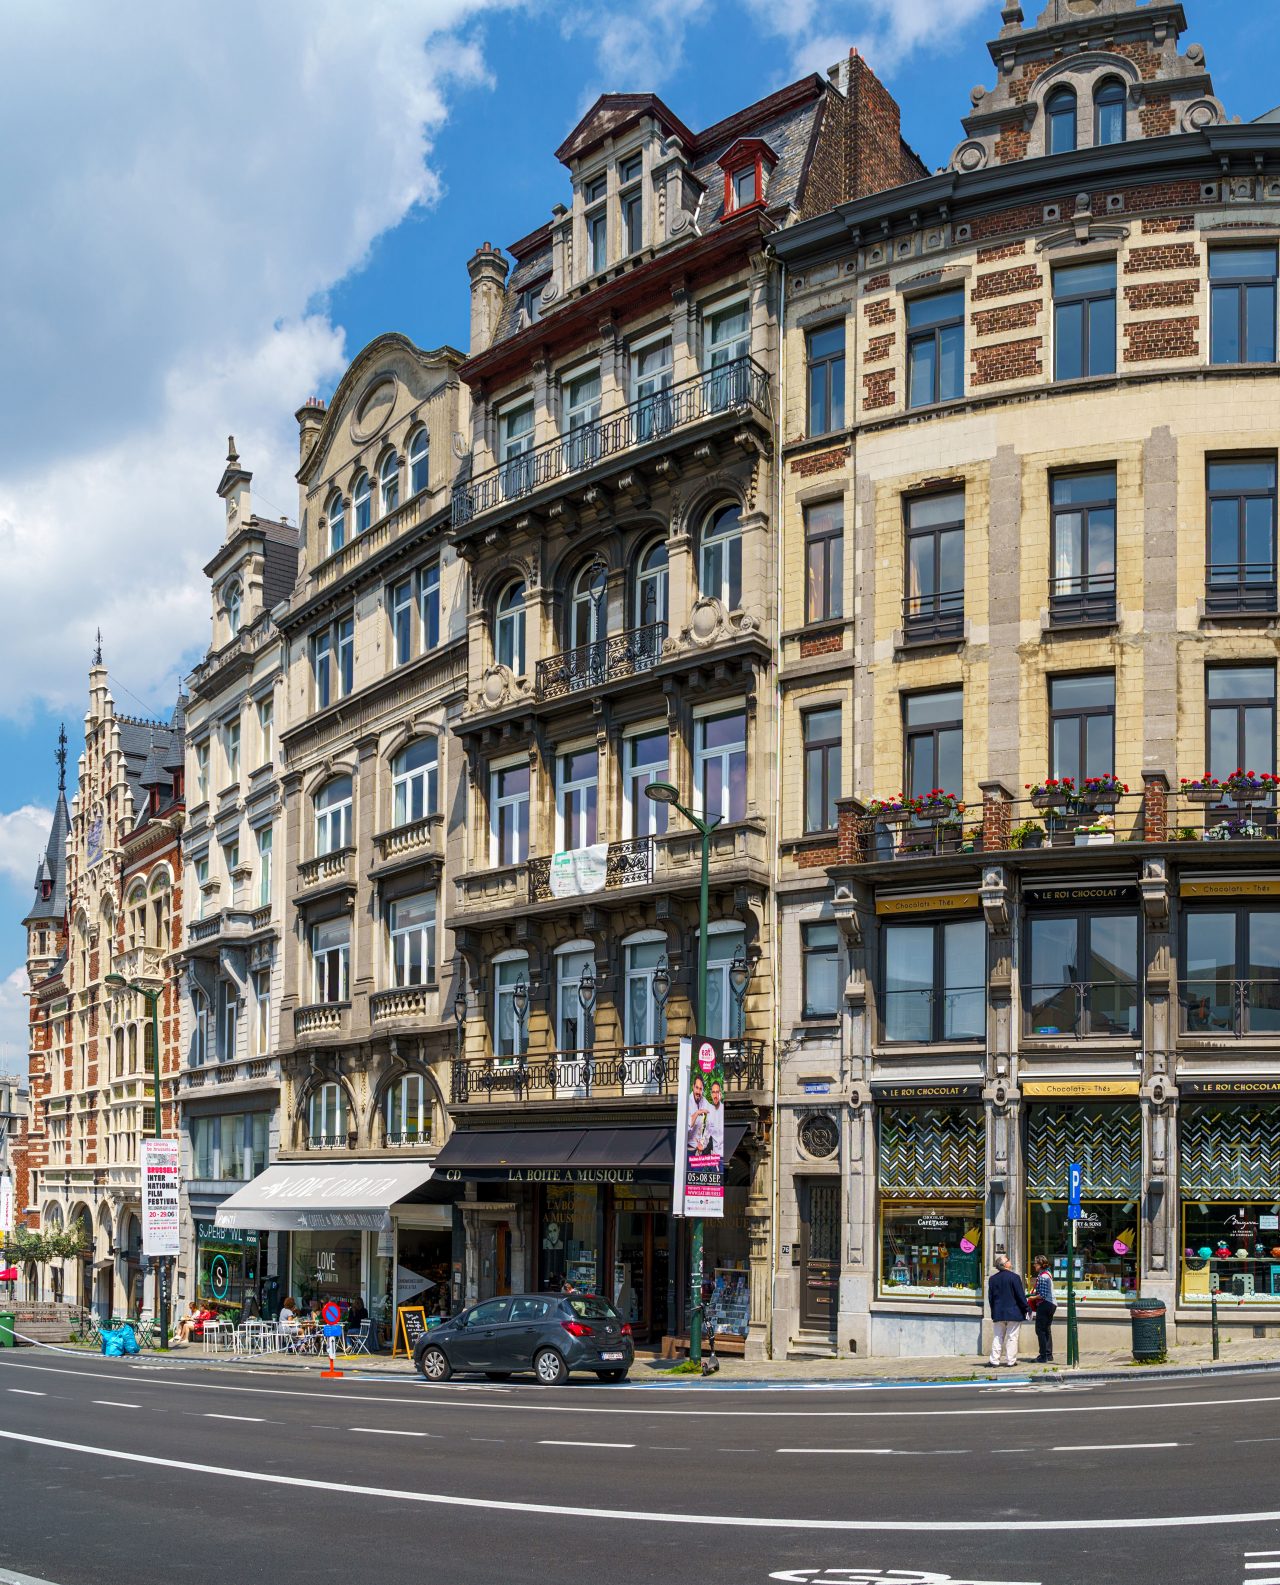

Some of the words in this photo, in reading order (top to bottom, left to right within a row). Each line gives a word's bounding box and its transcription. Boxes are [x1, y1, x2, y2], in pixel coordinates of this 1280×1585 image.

[1071, 889, 1117, 898] CHOCOLAT
[895, 902, 930, 910] Chocolats
[917, 1088, 959, 1096] CHOCOLAT
[1233, 1083, 1280, 1091] CHOCOLAT
[446, 1169, 462, 1181] CD
[508, 1169, 523, 1181] LA
[527, 1169, 561, 1181] BOITE
[565, 1169, 573, 1181] A
[577, 1169, 634, 1183] MUSIQUE
[1072, 1170, 1080, 1199] P
[316, 1251, 336, 1271] LOVE
[216, 1266, 223, 1288] S
